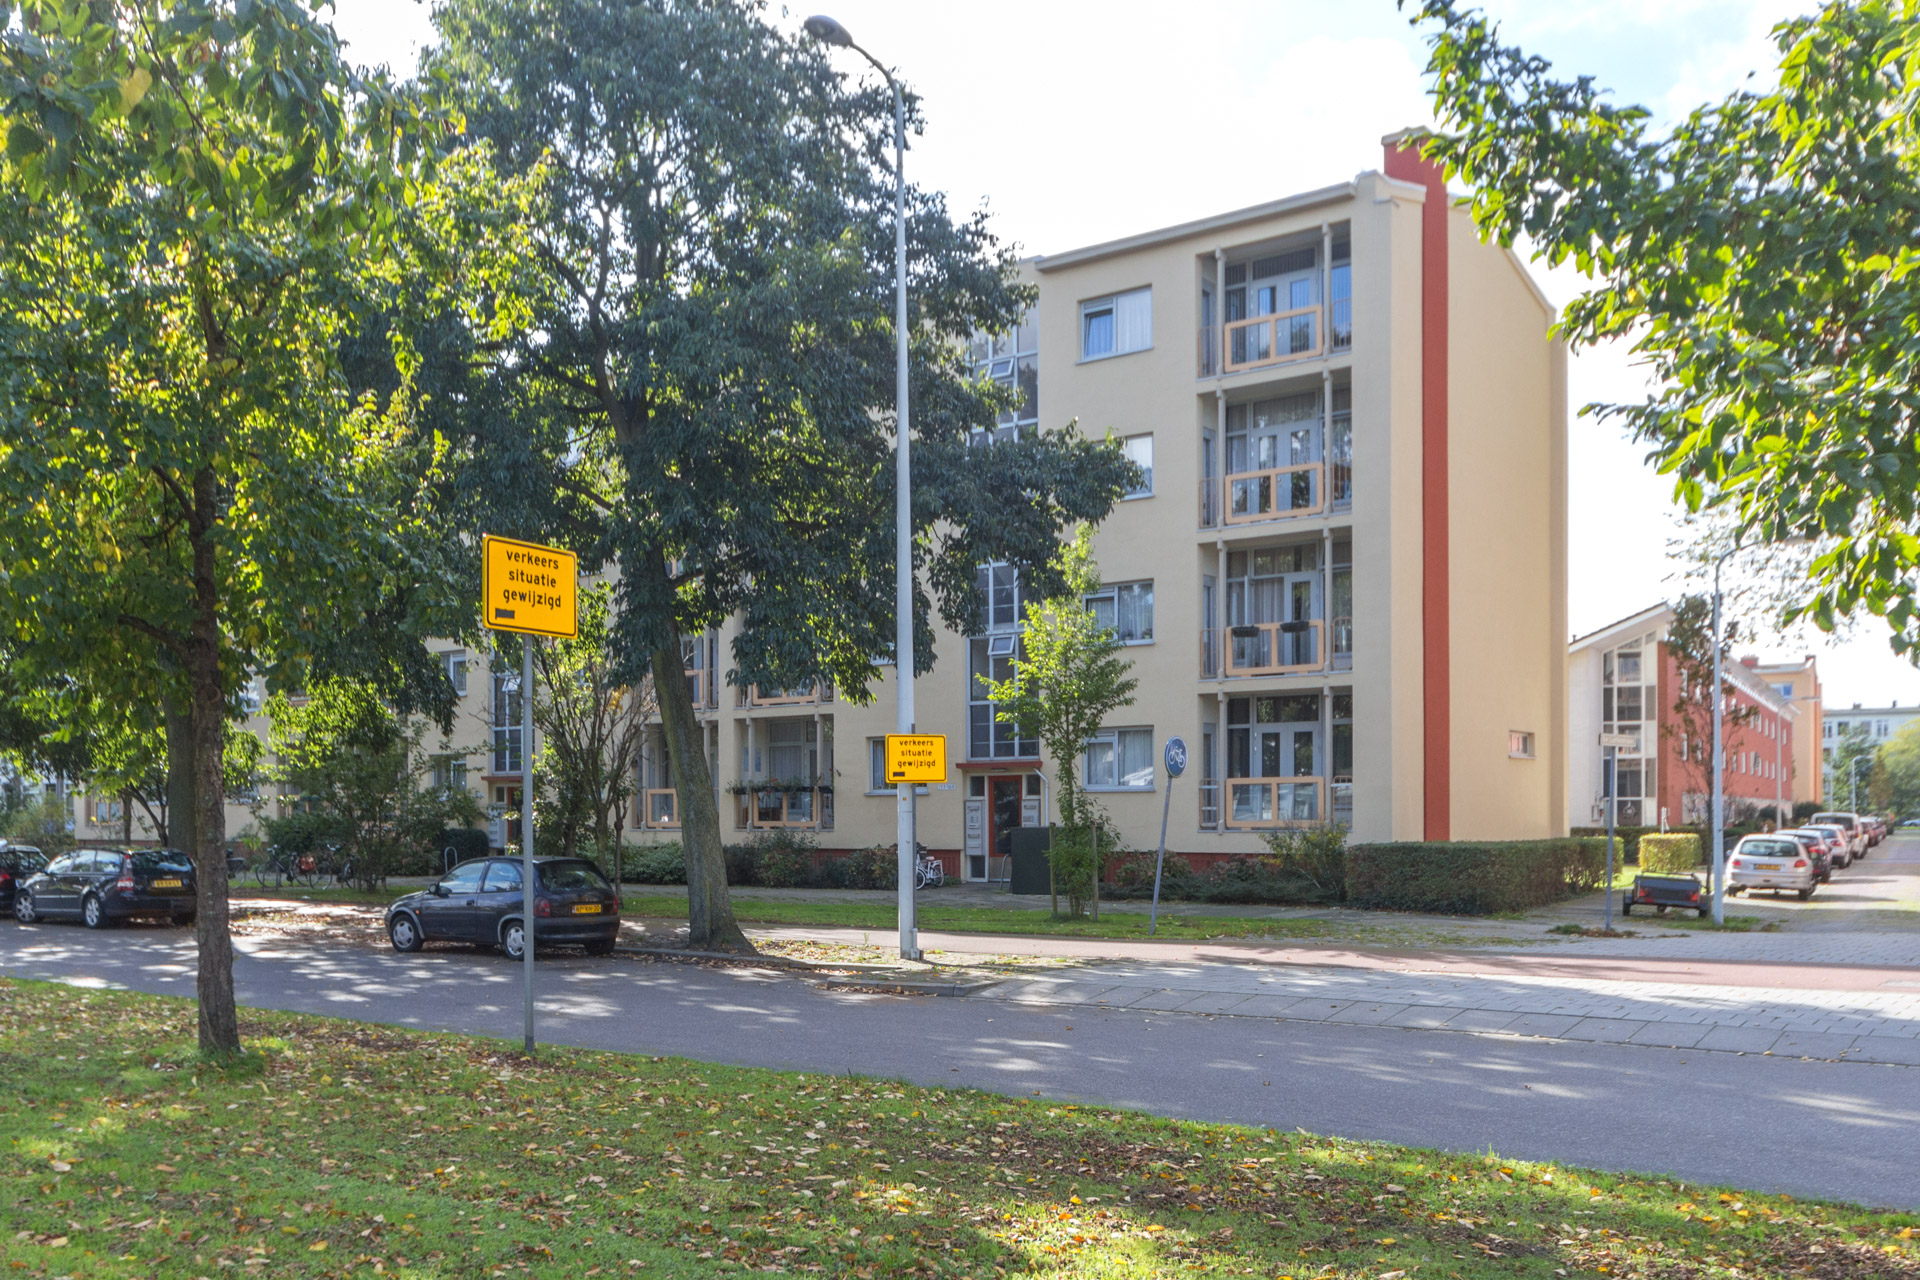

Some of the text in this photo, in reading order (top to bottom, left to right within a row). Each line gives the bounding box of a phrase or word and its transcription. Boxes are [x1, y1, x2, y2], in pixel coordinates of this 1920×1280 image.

[506, 550, 559, 570] verkeers
[509, 569, 557, 588] situatie
[503, 589, 561, 610] gewijzigd
[901, 749, 933, 757] situatie
[897, 760, 936, 769] gewijzigd
